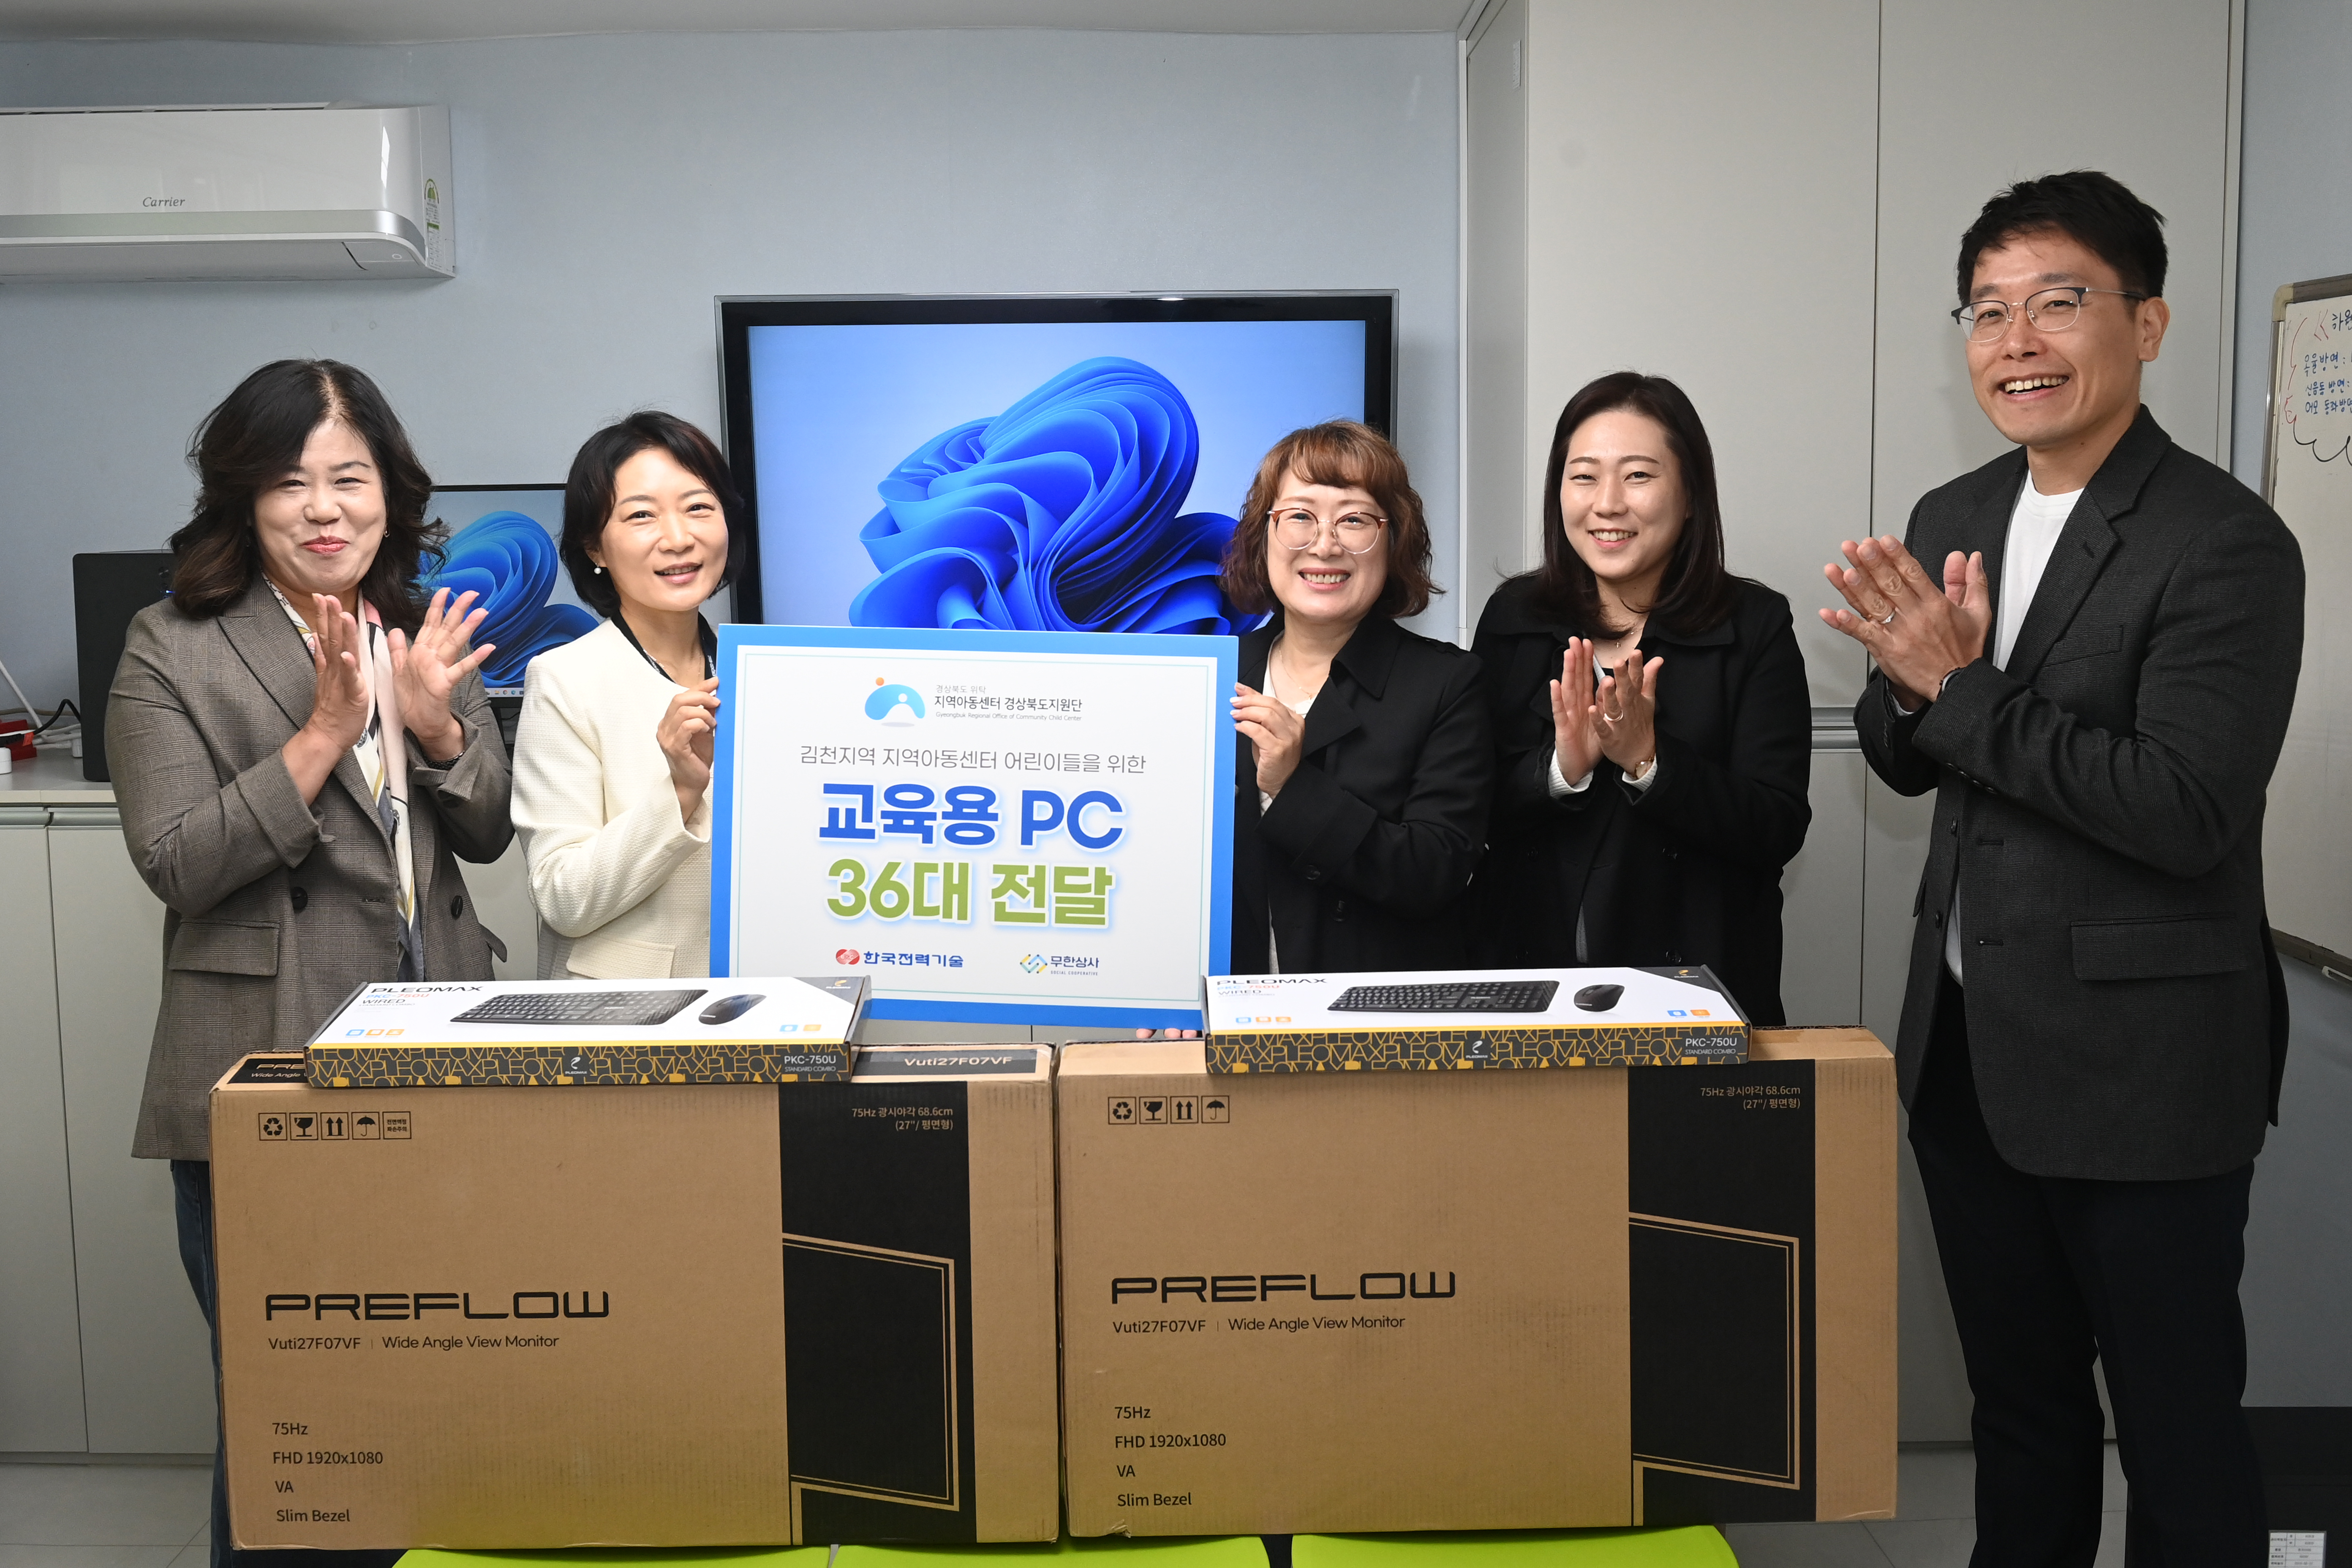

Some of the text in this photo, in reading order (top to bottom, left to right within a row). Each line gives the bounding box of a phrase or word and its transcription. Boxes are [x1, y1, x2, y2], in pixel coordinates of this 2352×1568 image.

[143, 197, 185, 207] Carrier
[2305, 400, 2318, 414] 어모
[936, 685, 986, 694] 경상북도 위탁
[934, 695, 1082, 712] 지역아동센터 경상북도지원단
[801, 746, 1146, 773] 김천지역 지역아동센터 어린이들을 위한
[819, 783, 1123, 849] 교육용 PC
[827, 858, 1113, 926] 36대 전달
[863, 951, 964, 968] 한국전력기술
[1051, 956, 1099, 968] 무한상사
[1685, 1038, 1737, 1047] PKC-750U
[784, 1056, 836, 1064] PKC-750U
[904, 1056, 1013, 1067] Vuti27F07VF
[1701, 1086, 1800, 1097] 75Hz 광시야각 68.6cm
[1769, 1098, 1800, 1109] 평면형)
[852, 1107, 953, 1118] 75Hz 광시야각 68.6cm
[922, 1119, 953, 1130] 평면형)
[1112, 1271, 1455, 1304] PREFLOW
[266, 1291, 609, 1320] PREFLOW
[1113, 1315, 1405, 1333] Vuti27F07VF Wide Angle View Monitor
[268, 1335, 559, 1351] Vuti27F07VF Wide Angle View Monitor
[1115, 1406, 1151, 1418] 75Hz
[272, 1423, 308, 1435] 75Hz
[1116, 1434, 1226, 1448] FHD 1920x1080
[273, 1451, 383, 1465] FHD 1920x1080
[1117, 1465, 1135, 1477] VA
[275, 1481, 294, 1492] VA
[1117, 1492, 1192, 1506] Slim Bezel
[276, 1509, 350, 1522] Slim Bezel
